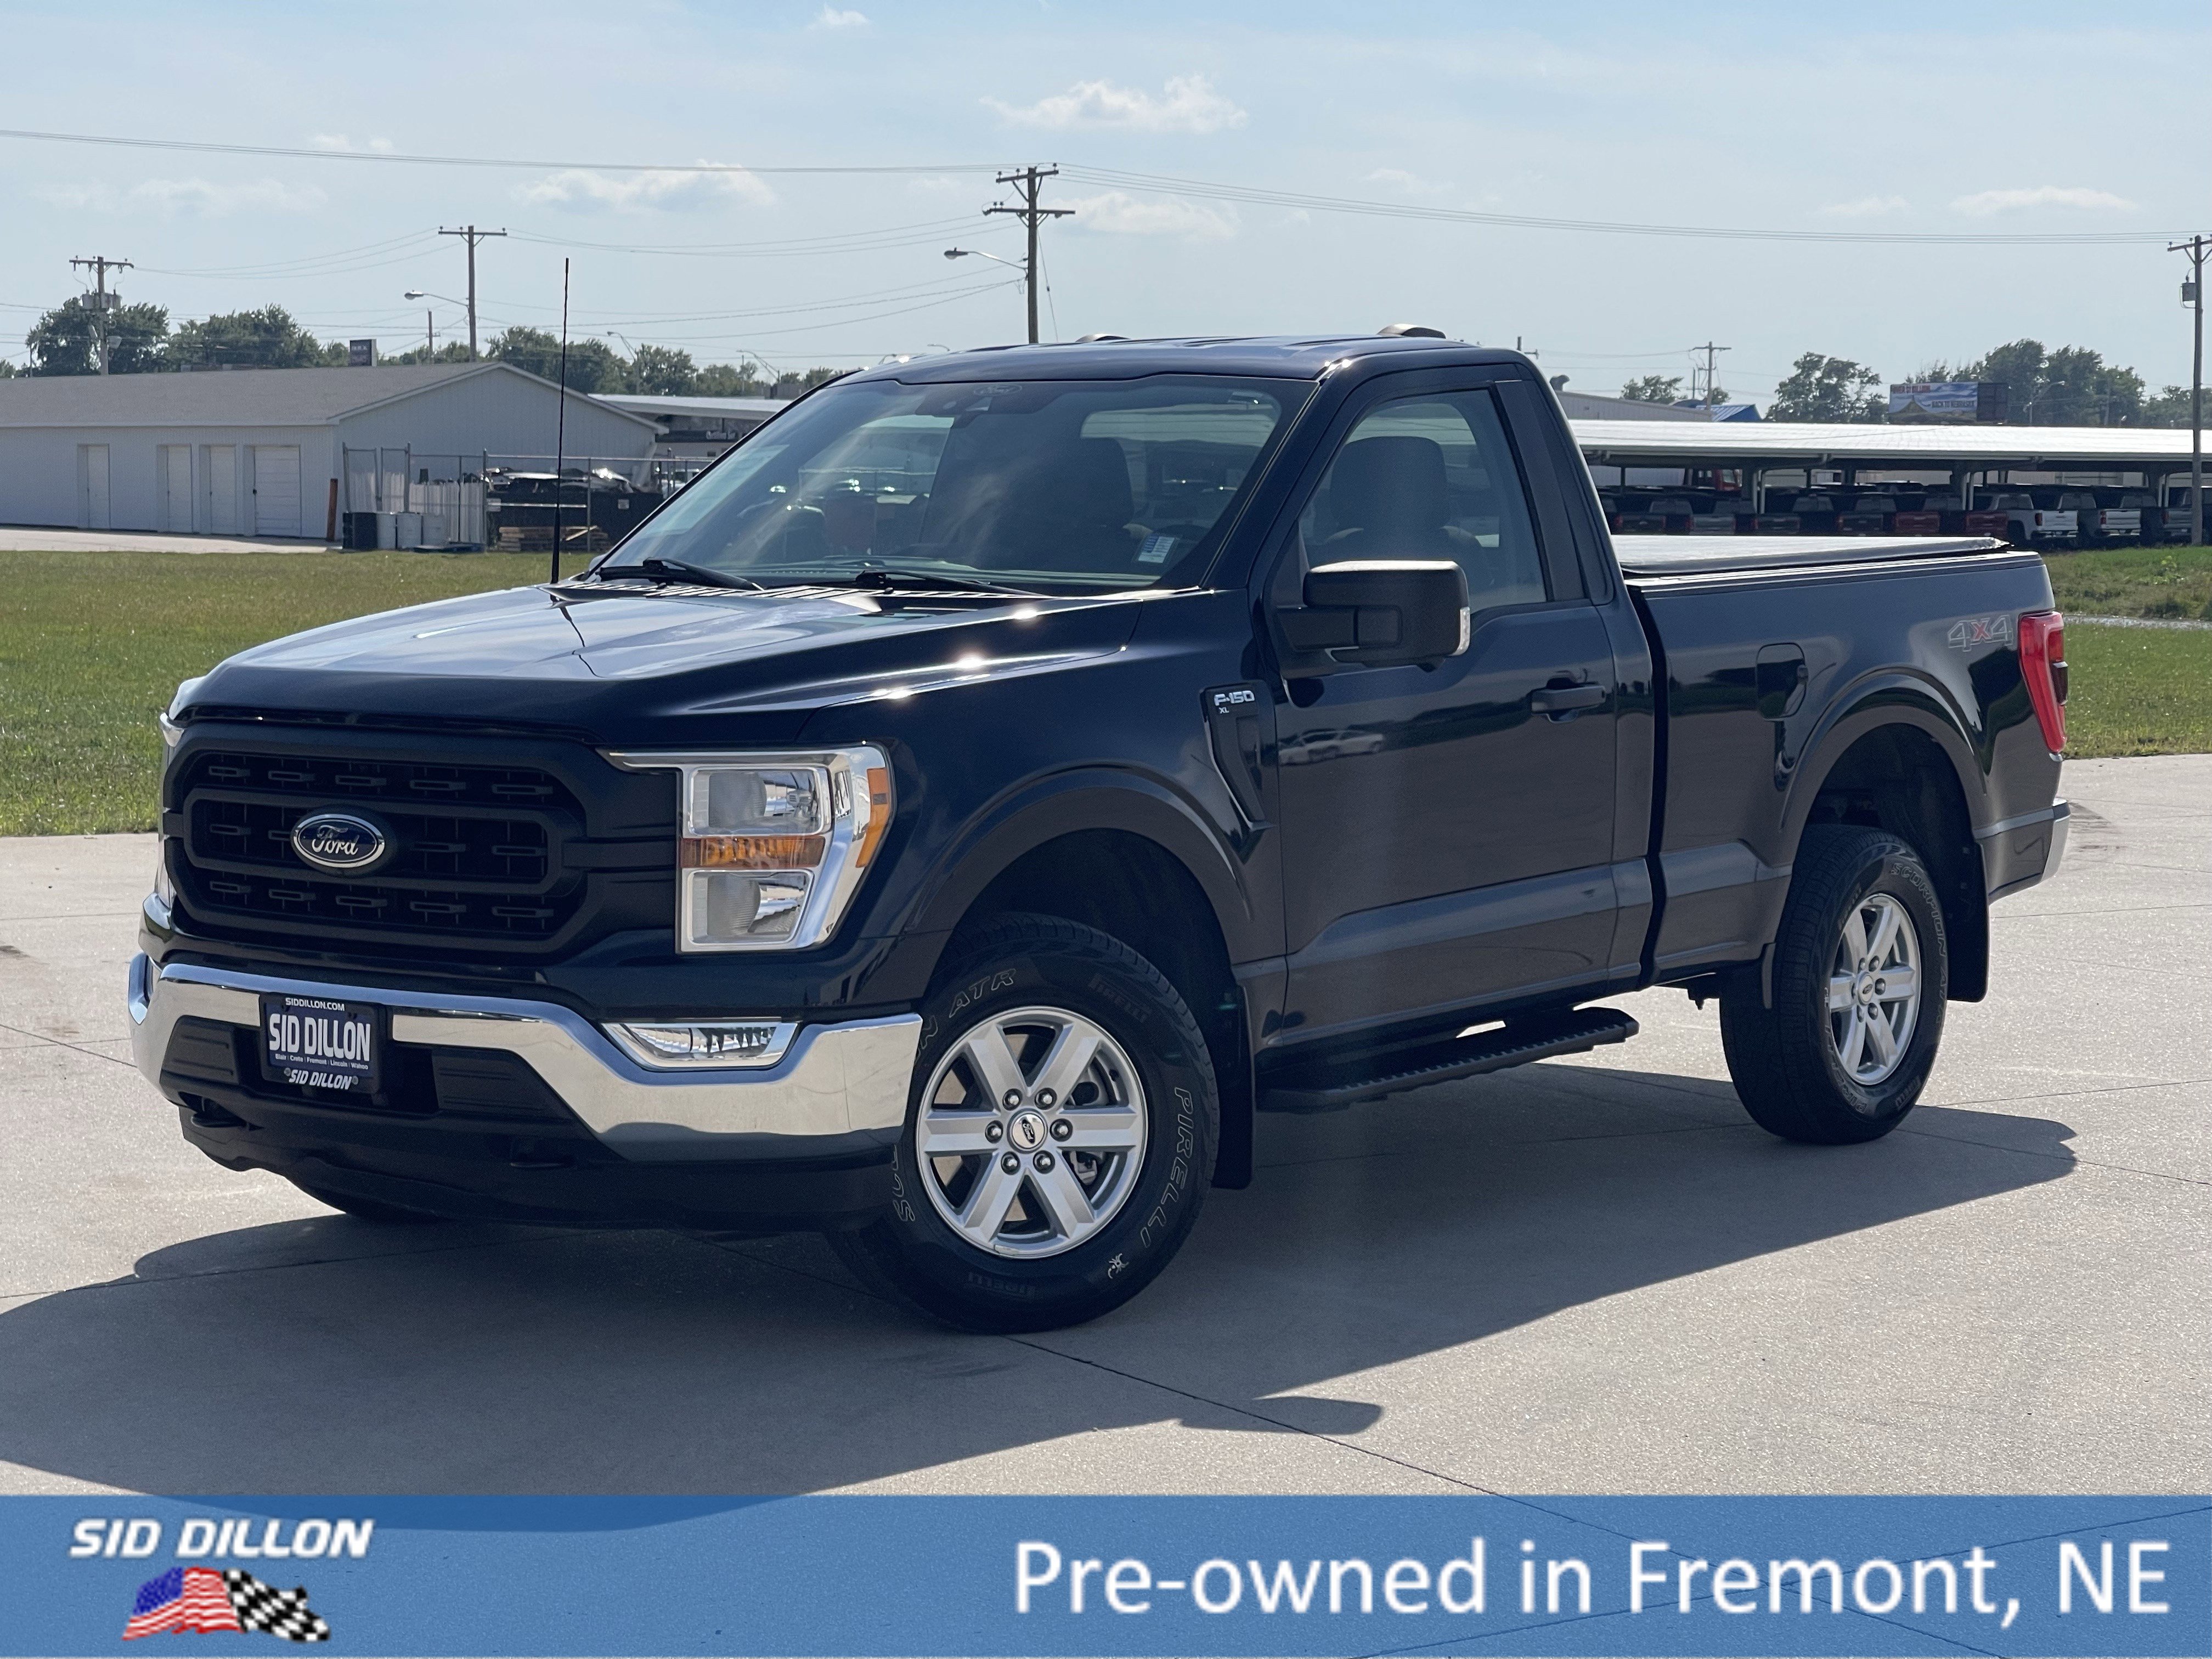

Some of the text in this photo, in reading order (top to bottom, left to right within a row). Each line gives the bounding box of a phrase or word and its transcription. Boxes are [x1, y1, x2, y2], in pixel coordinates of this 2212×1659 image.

[1214, 690, 1255, 706] F-150
[312, 825, 360, 855] Ford
[1891, 862, 1947, 957] SCORPION
[285, 997, 345, 1012] SIDDILLON.COM
[949, 968, 1015, 1018] ATR
[269, 1013, 370, 1062] SID DILLON
[289, 1069, 353, 1090] SID DILLON
[1141, 1087, 1194, 1248] PIRELLI
